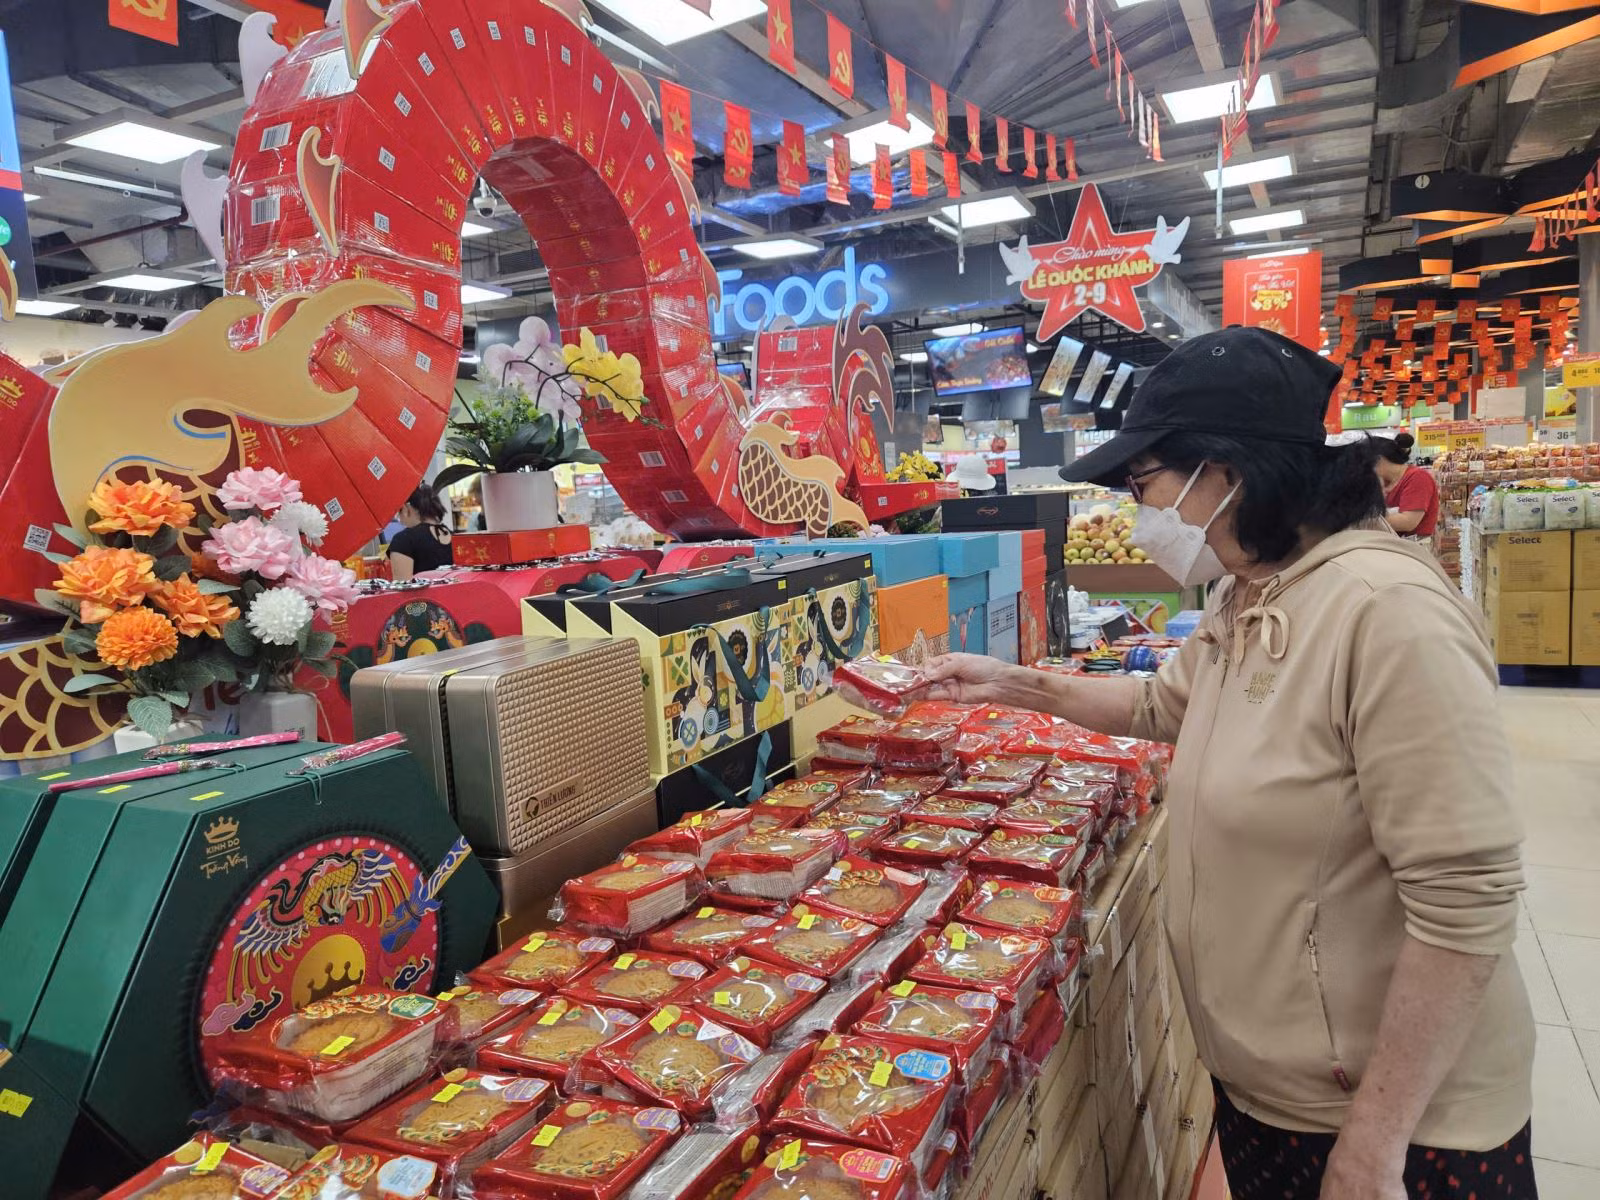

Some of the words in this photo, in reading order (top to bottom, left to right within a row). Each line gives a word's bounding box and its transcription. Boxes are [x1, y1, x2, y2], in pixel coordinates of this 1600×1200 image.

[1053, 245, 1093, 263] Chào
[1047, 264, 1094, 287] QUỐC
[1095, 258, 1154, 281] KHÁNH
[711, 246, 889, 336] Foods
[1073, 282, 1106, 306] 2-9
[1516, 495, 1540, 503] Select
[1552, 494, 1577, 503] Select
[1508, 536, 1542, 545] Select
[206, 842, 227, 855] KINH
